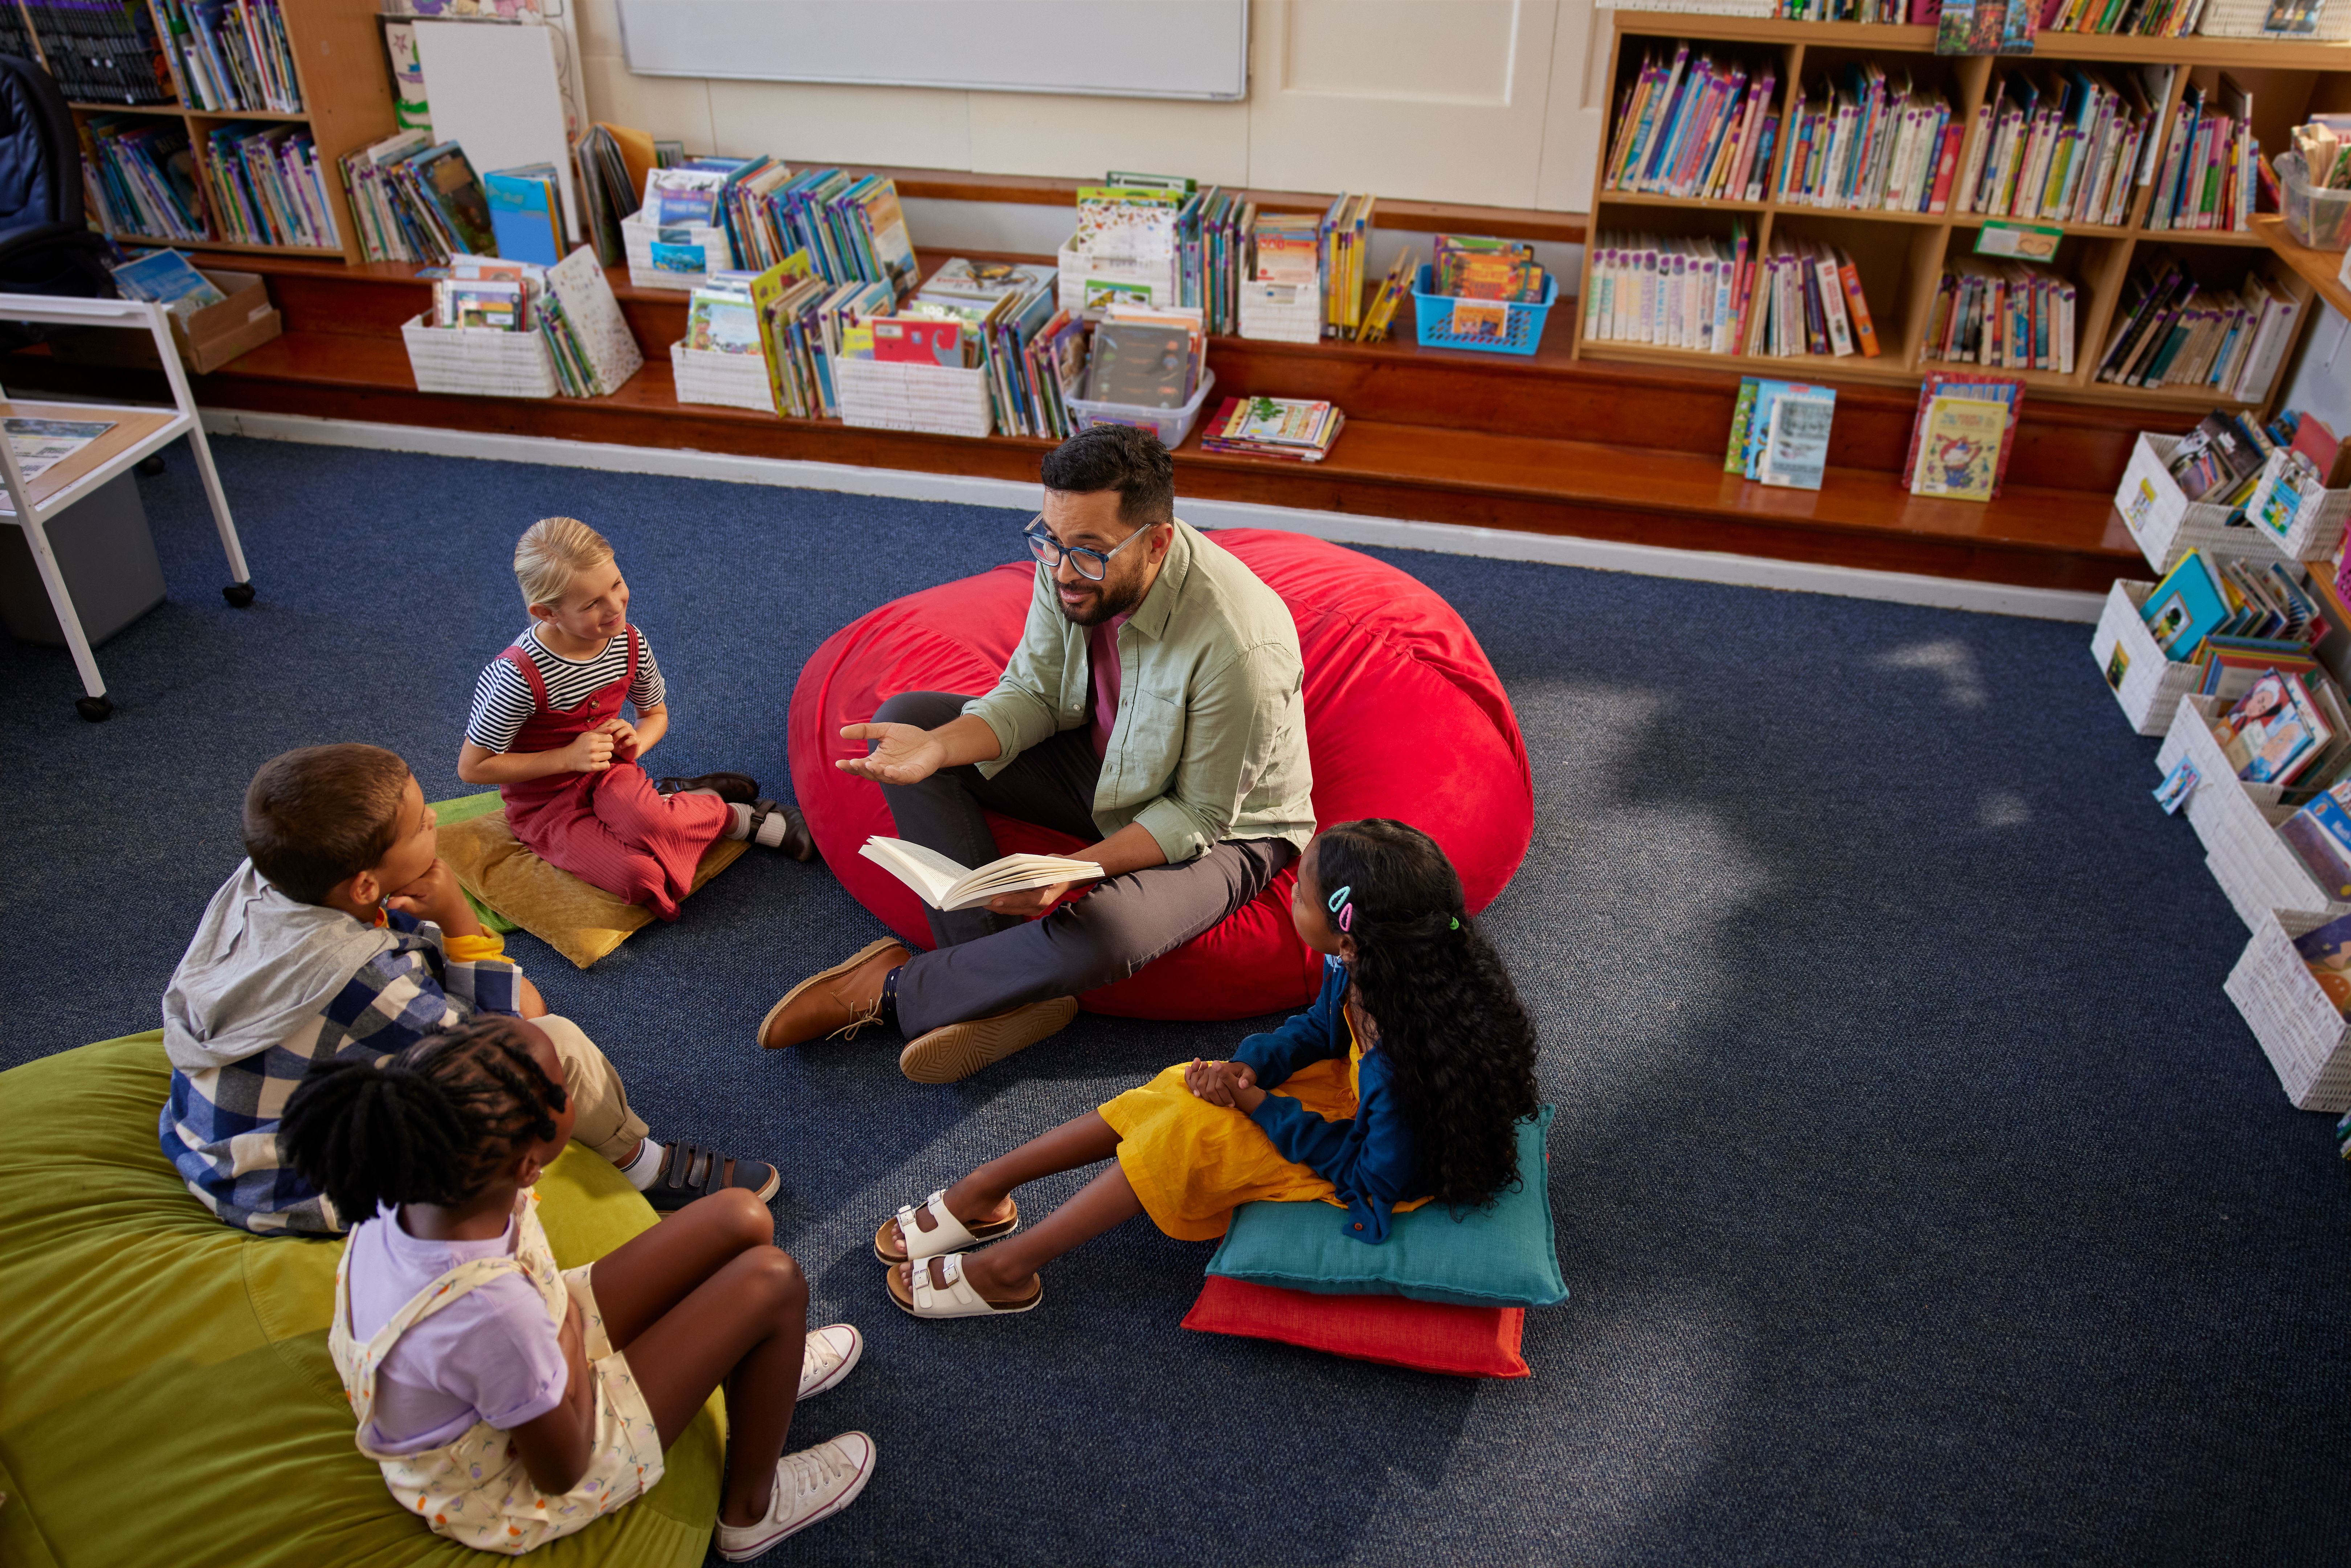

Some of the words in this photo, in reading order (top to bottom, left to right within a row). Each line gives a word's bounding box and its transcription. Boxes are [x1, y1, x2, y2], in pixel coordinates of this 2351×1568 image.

[1586, 275, 1601, 318] SHARKS
[1600, 278, 1613, 315] BODY
[1641, 275, 1653, 327] HISTORY
[1655, 280, 1665, 327] ANIMALS
[1670, 280, 1681, 327] HISTORY
